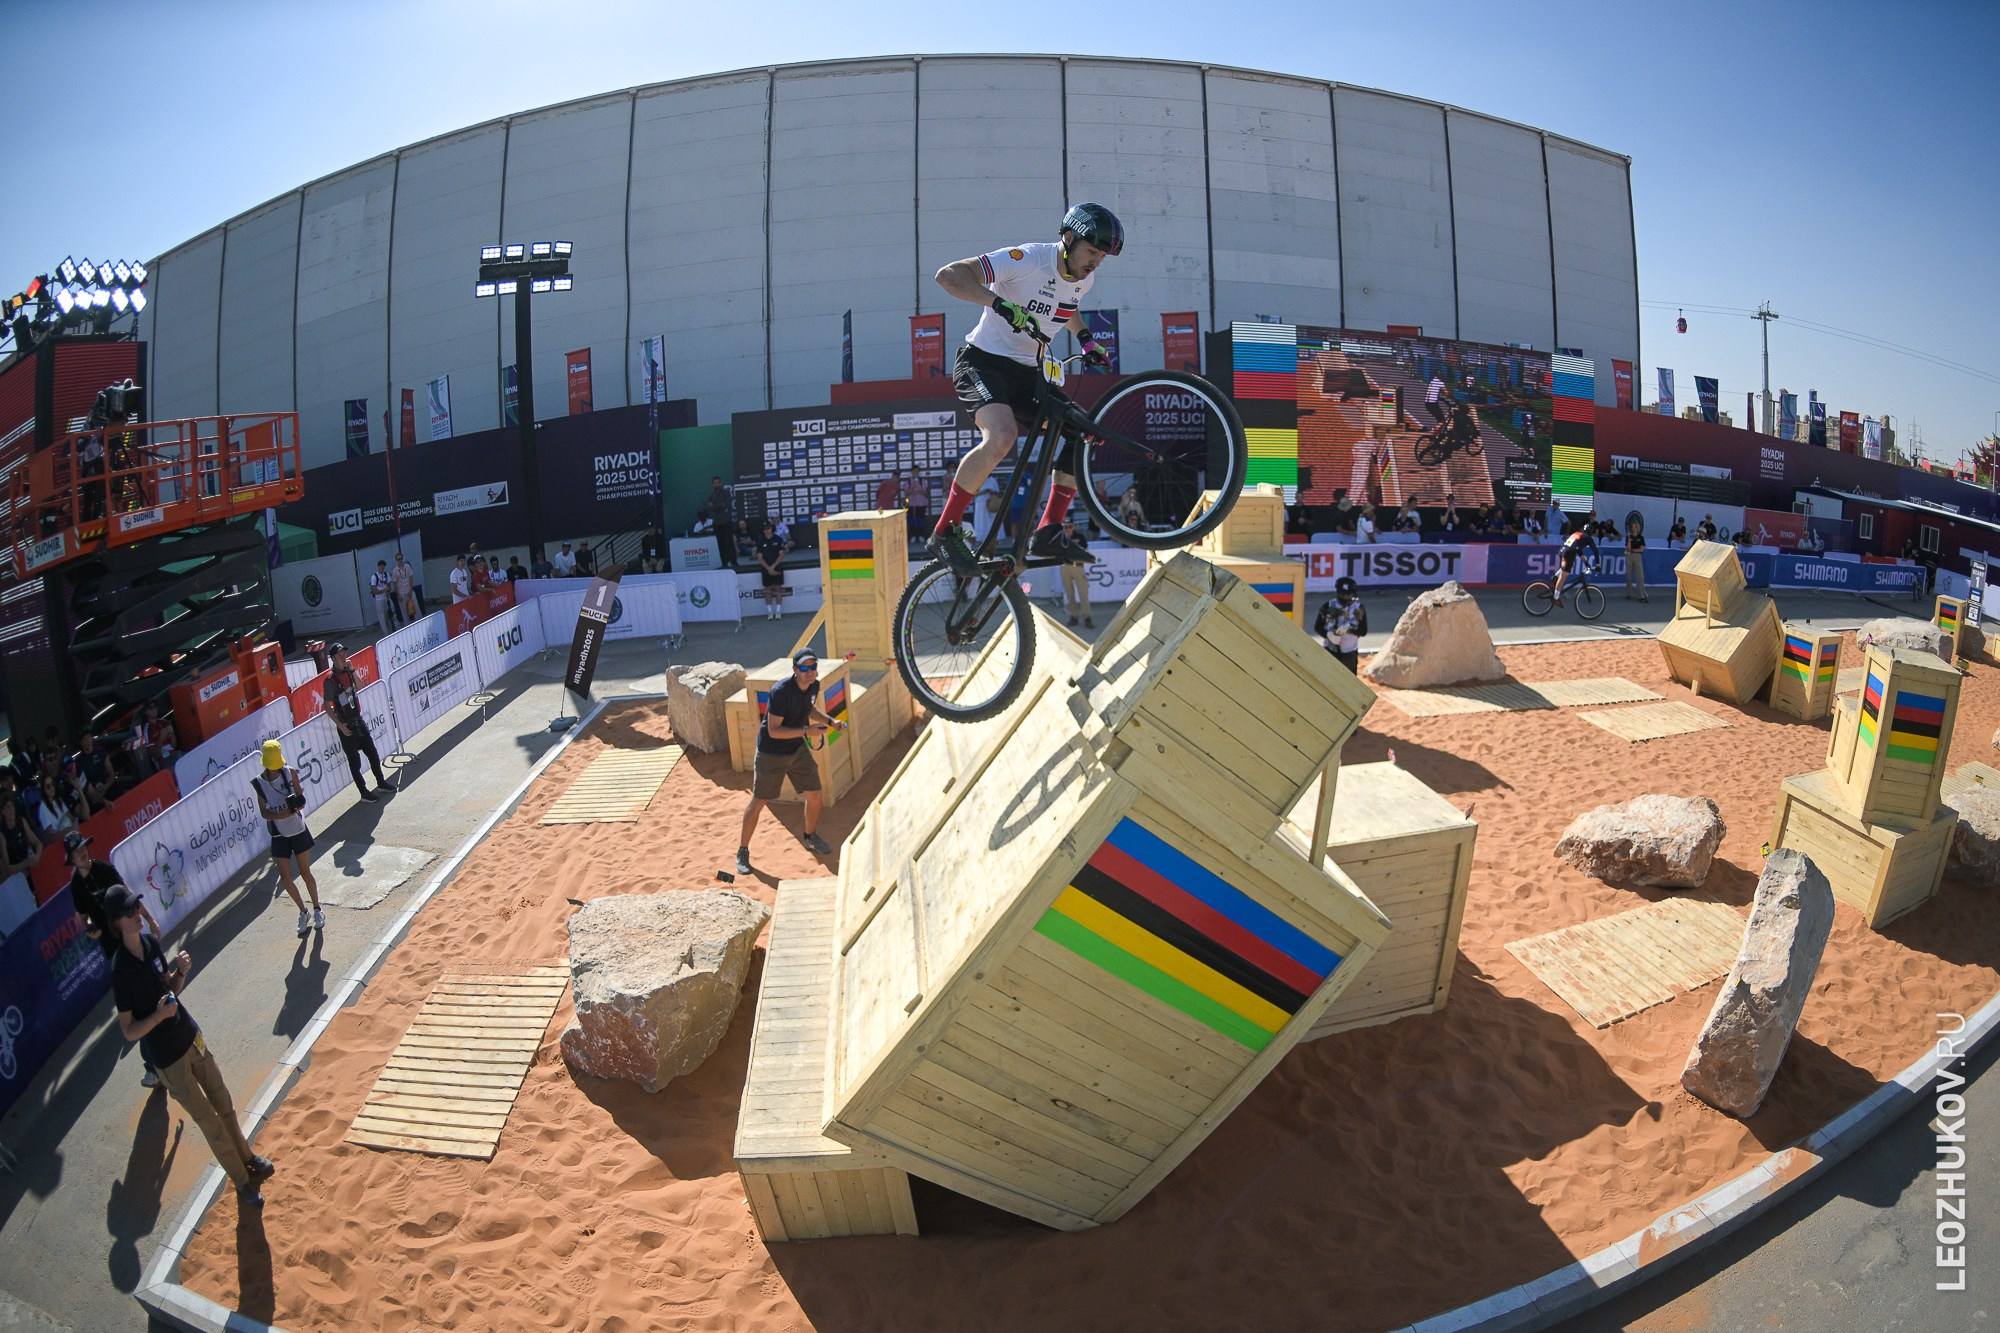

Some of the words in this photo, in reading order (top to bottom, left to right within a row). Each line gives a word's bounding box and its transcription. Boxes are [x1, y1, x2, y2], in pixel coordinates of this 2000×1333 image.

[1027, 299, 1052, 317] GBR
[1092, 331, 1115, 340] YADH
[1145, 394, 1204, 409] RIYADH
[847, 422, 890, 430] CHAMPIONSHIPS
[1145, 412, 1178, 425] 2025
[1181, 412, 1205, 425] UCI
[798, 422, 824, 434] UCI
[594, 449, 650, 472] RIYADH
[1761, 448, 1785, 461] RIYADH
[1761, 460, 1774, 469] 2025
[1774, 461, 1784, 471] UCI
[595, 470, 626, 486] 2025
[629, 468, 649, 482] UC
[437, 493, 458, 503] RIYADH
[596, 489, 649, 501] CHAMPIONSHIP
[438, 502, 456, 512] SAUDI
[456, 498, 479, 509] ARABIA
[133, 511, 155, 522] SUDHIR
[363, 508, 376, 518] 2025
[334, 512, 360, 531] UCI
[364, 516, 384, 526] WORLD
[1780, 531, 1796, 539] RIYADH
[35, 536, 61, 559] SUDHIR
[684, 548, 708, 556] RIYADH
[1340, 552, 1460, 577] TISSOT
[1119, 569, 1146, 577] SAUD
[1794, 562, 1847, 583] SHIMANO
[1875, 571, 1916, 586] SHIMANO
[1975, 576, 1980, 588] 1
[596, 585, 608, 607] 1
[739, 591, 752, 599] UCI
[588, 610, 603, 620] UCI
[502, 624, 523, 652] UCI
[573, 628, 595, 685] #Riyadh2025
[211, 676, 231, 692] SUDHIR
[413, 675, 428, 694] UCI
[324, 740, 342, 761] SAU
[124, 797, 163, 834] RIYADH
[229, 796, 255, 826] وزارة
[190, 810, 227, 850] الرياضة
[195, 843, 227, 874] Ministry
[227, 831, 236, 849] of
[236, 815, 260, 842] Sport
[40, 914, 82, 963] RIYAD
[50, 947, 77, 981] 2025
[76, 934, 93, 956] UC
[61, 954, 105, 1001] CHAMPIONSHIPS
